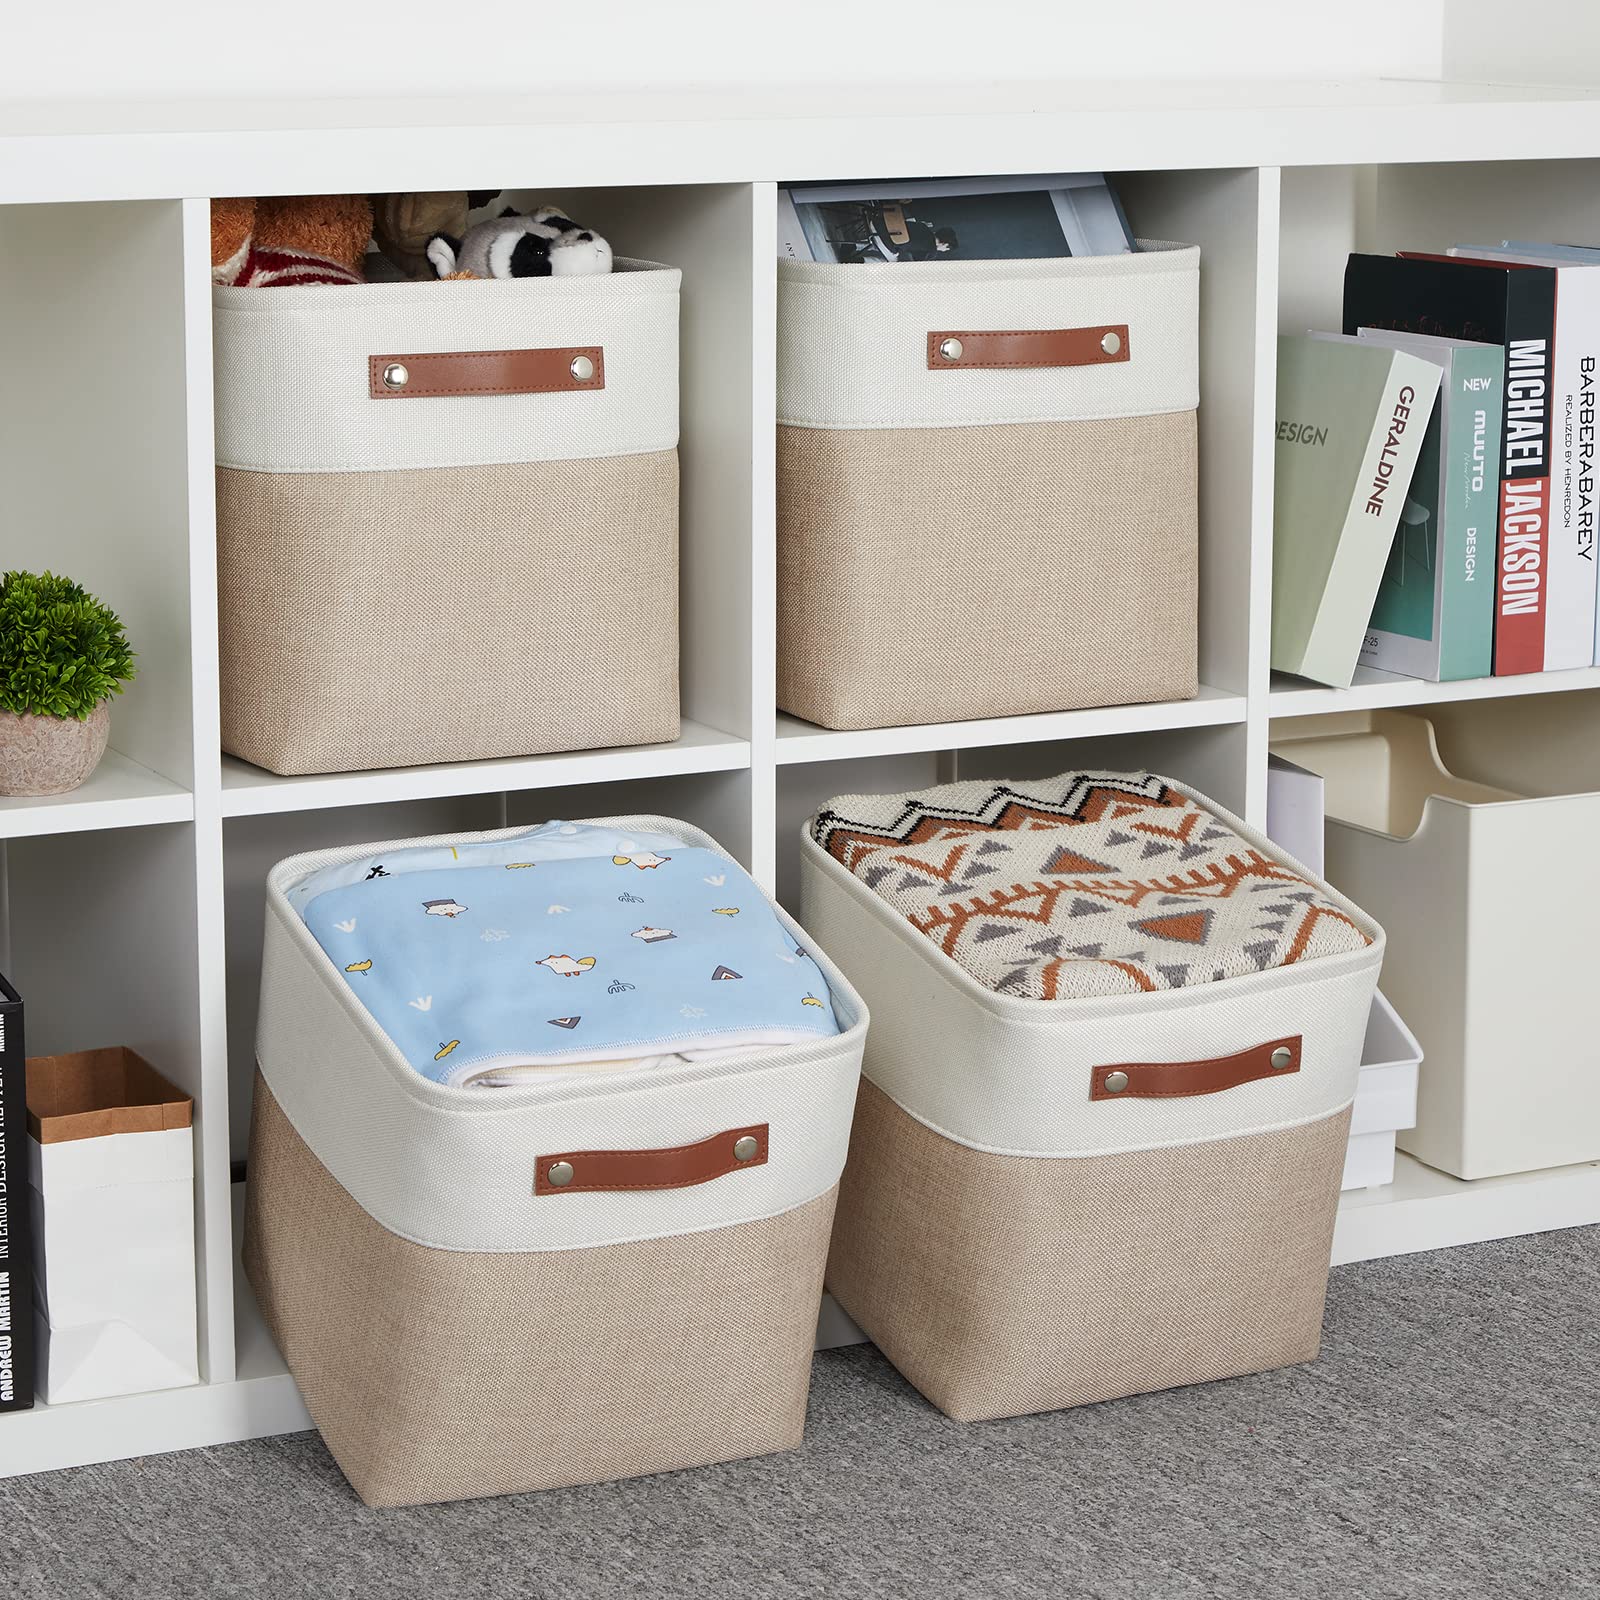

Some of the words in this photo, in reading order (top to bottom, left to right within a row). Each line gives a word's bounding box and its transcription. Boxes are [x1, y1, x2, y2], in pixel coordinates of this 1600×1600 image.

[1463, 377, 1492, 392] NEW
[1505, 338, 1546, 476] MICHAEL
[1365, 385, 1415, 517] GERALDINE
[1564, 394, 1573, 449] REALIZED
[1564, 450, 1573, 466] BY
[1577, 355, 1596, 562] BARBERABAREY
[1563, 468, 1572, 528] HENREDON
[1465, 527, 1477, 582] DESIGN
[1502, 479, 1542, 617] JACKSON
[0, 1271, 11, 1331] MARTIN
[0, 1335, 14, 1402] ANDREW
